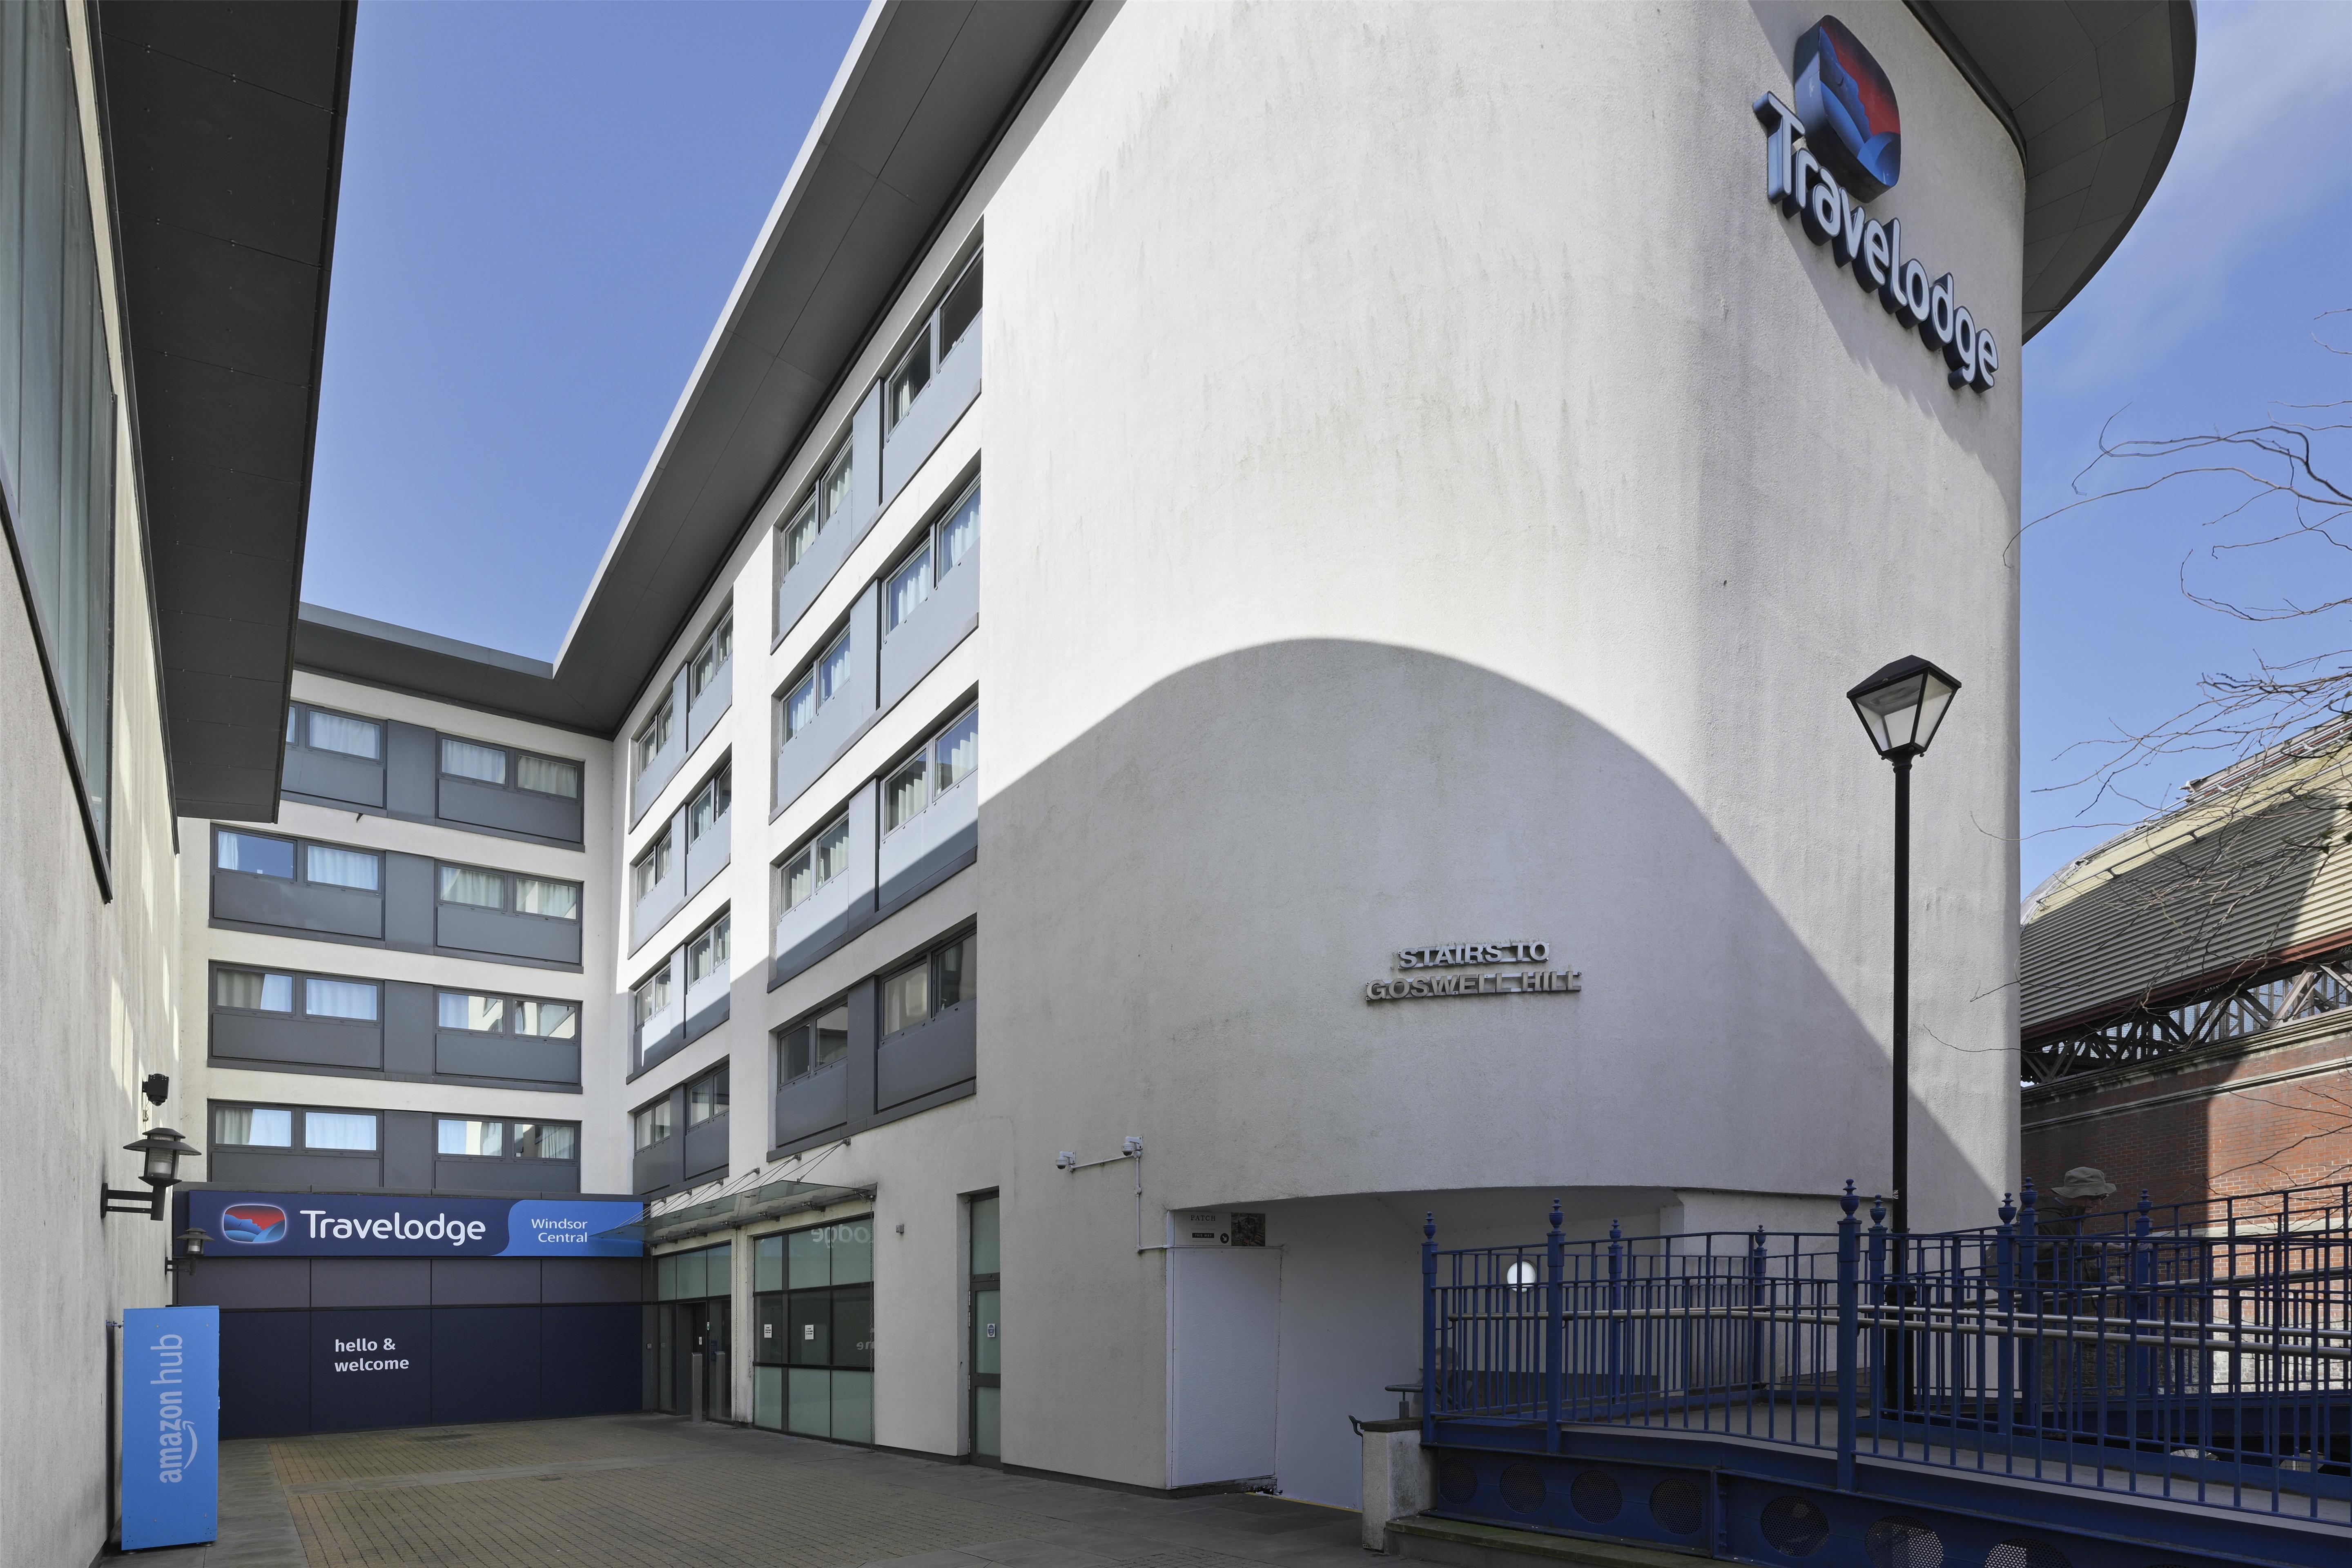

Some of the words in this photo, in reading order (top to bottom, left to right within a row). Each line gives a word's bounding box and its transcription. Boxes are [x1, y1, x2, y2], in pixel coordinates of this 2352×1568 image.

[1753, 91, 1998, 393] Travelodge
[1400, 942, 1503, 969] STAIRS
[1512, 941, 1549, 961] TO
[1367, 972, 1510, 1000] GOSWELL
[1522, 971, 1581, 991] HILL
[299, 1210, 486, 1246] Travelodge
[531, 1218, 588, 1229] Windsor
[538, 1232, 587, 1243] Central
[150, 1334, 182, 1384] hub
[335, 1338, 378, 1352] hello
[383, 1338, 396, 1350] &
[334, 1358, 409, 1372] welcome
[159, 1391, 182, 1483] amazon
